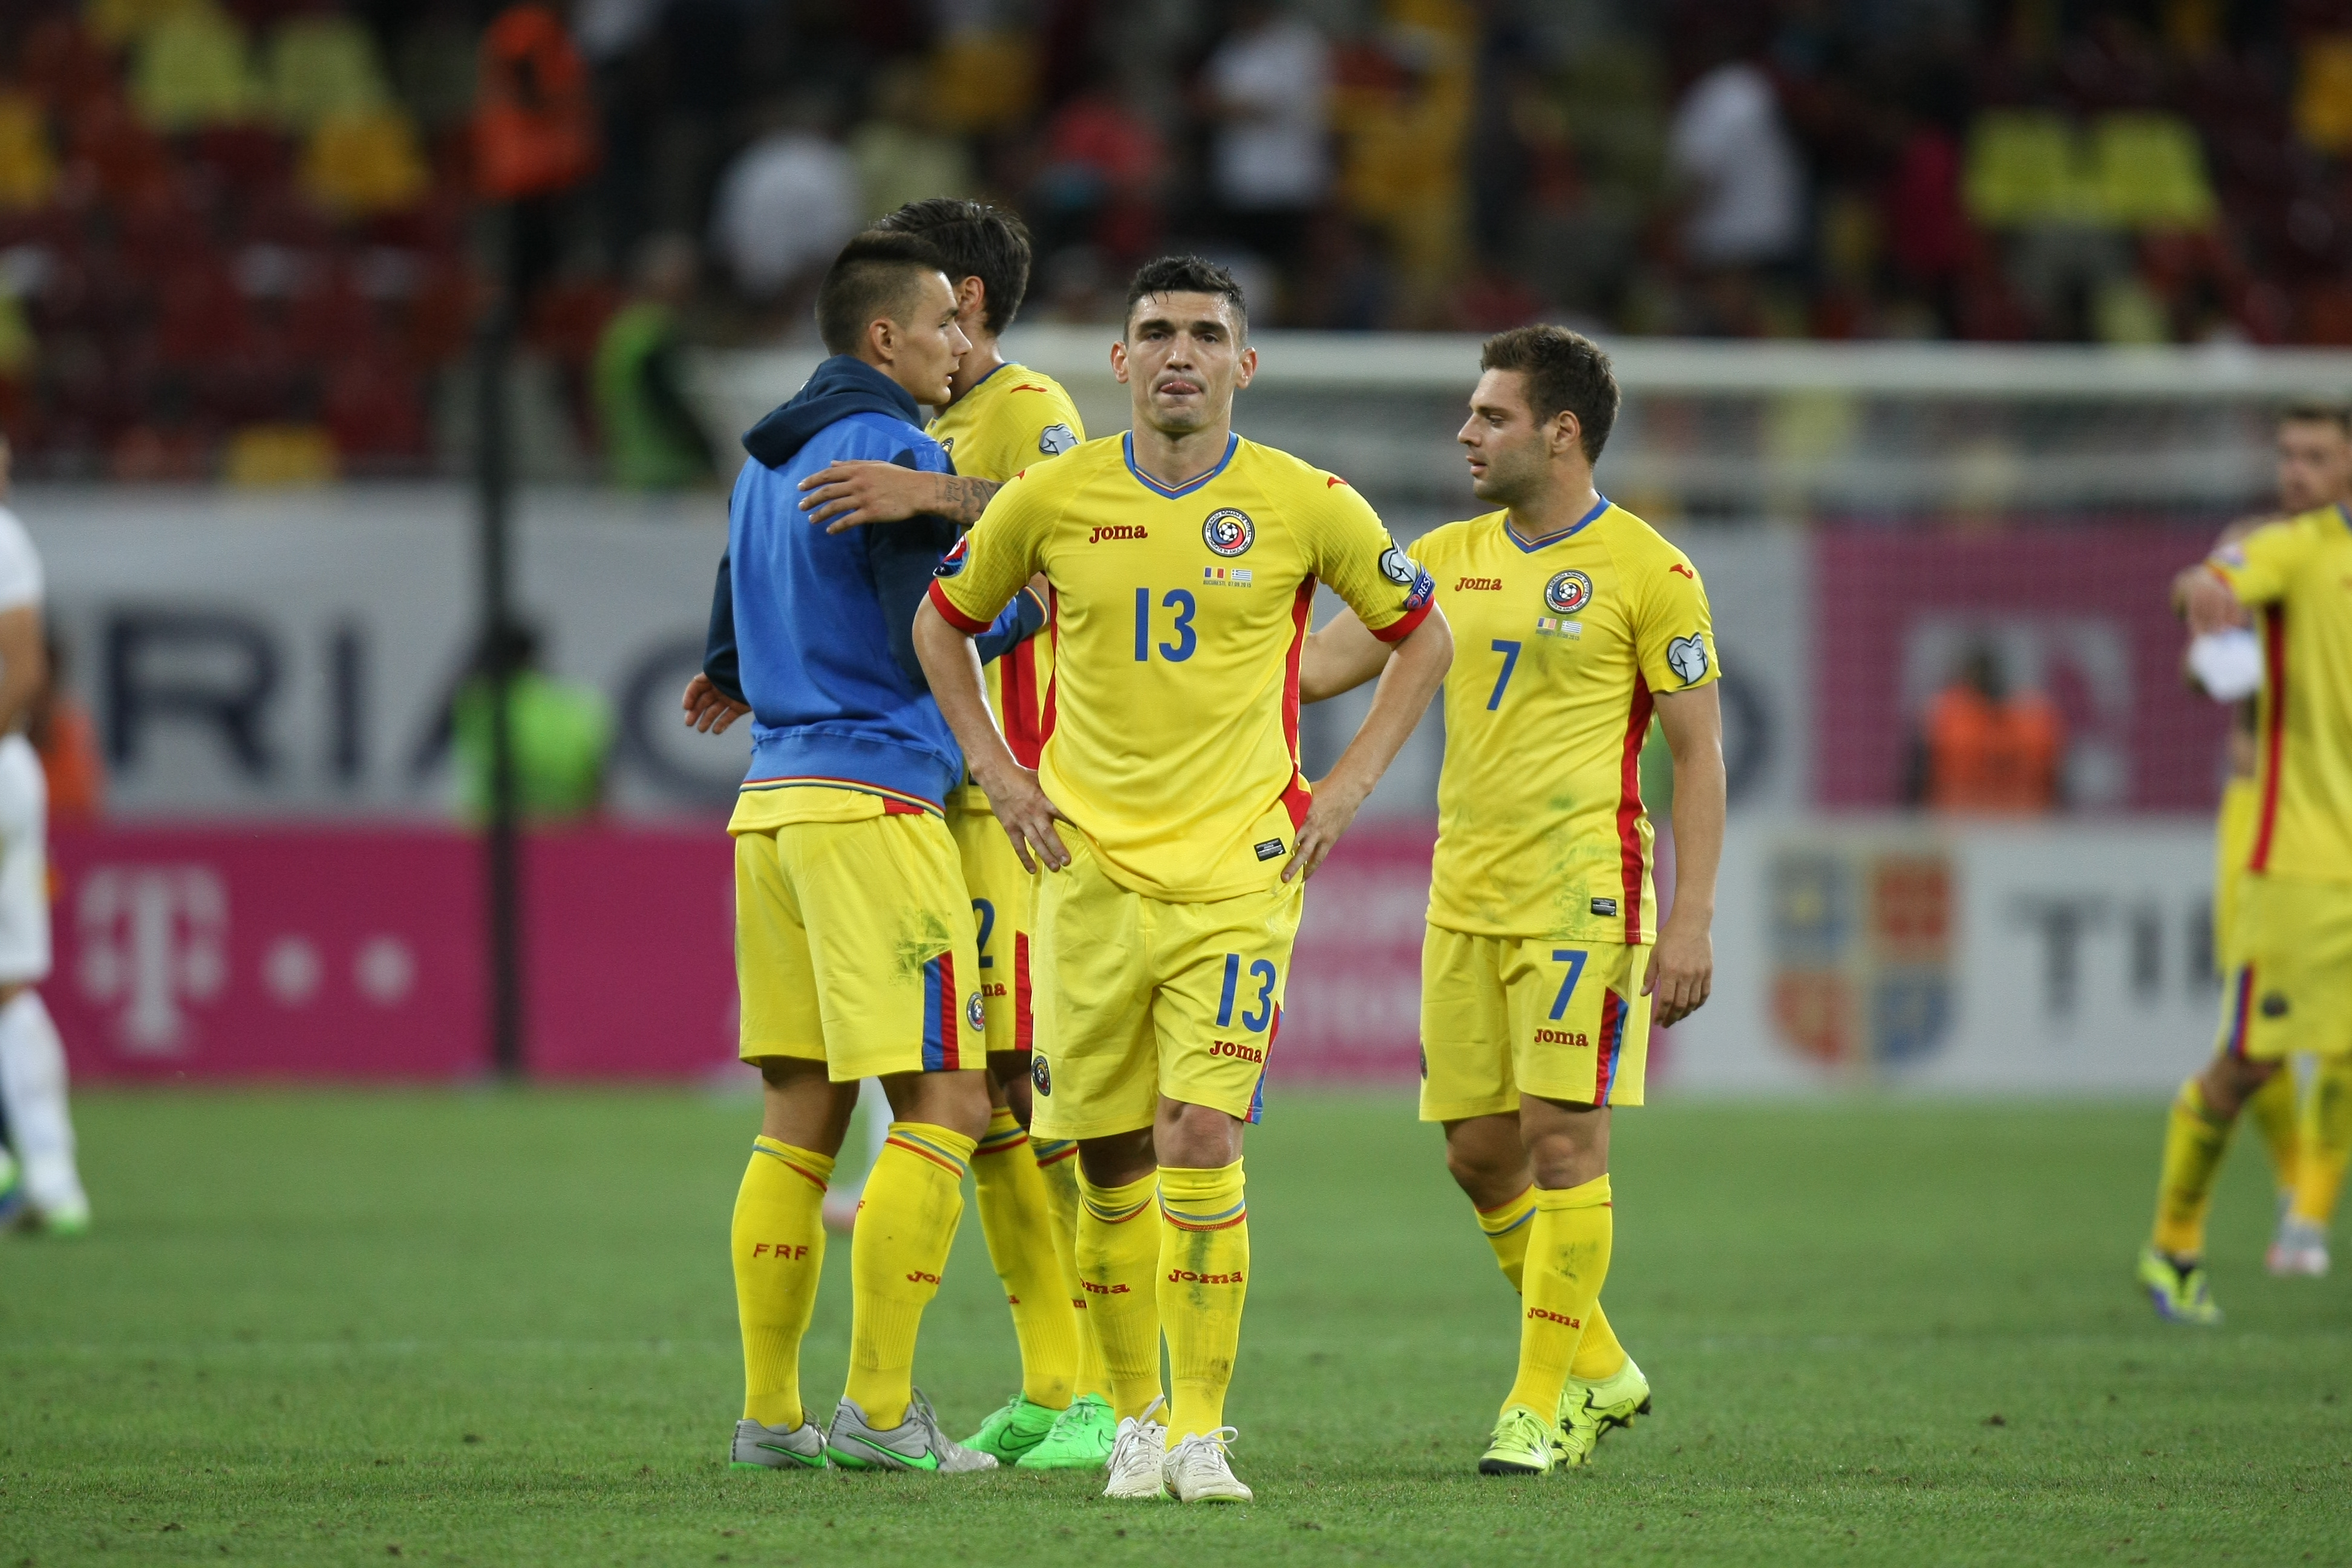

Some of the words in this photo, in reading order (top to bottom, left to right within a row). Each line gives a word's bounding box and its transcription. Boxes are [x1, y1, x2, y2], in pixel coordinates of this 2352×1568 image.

[1134, 587, 1197, 662] 13
[1486, 638, 1521, 711] 7
[1215, 953, 1276, 1033] 13
[1548, 949, 1588, 1020] 7
[753, 1243, 809, 1260] FRF
